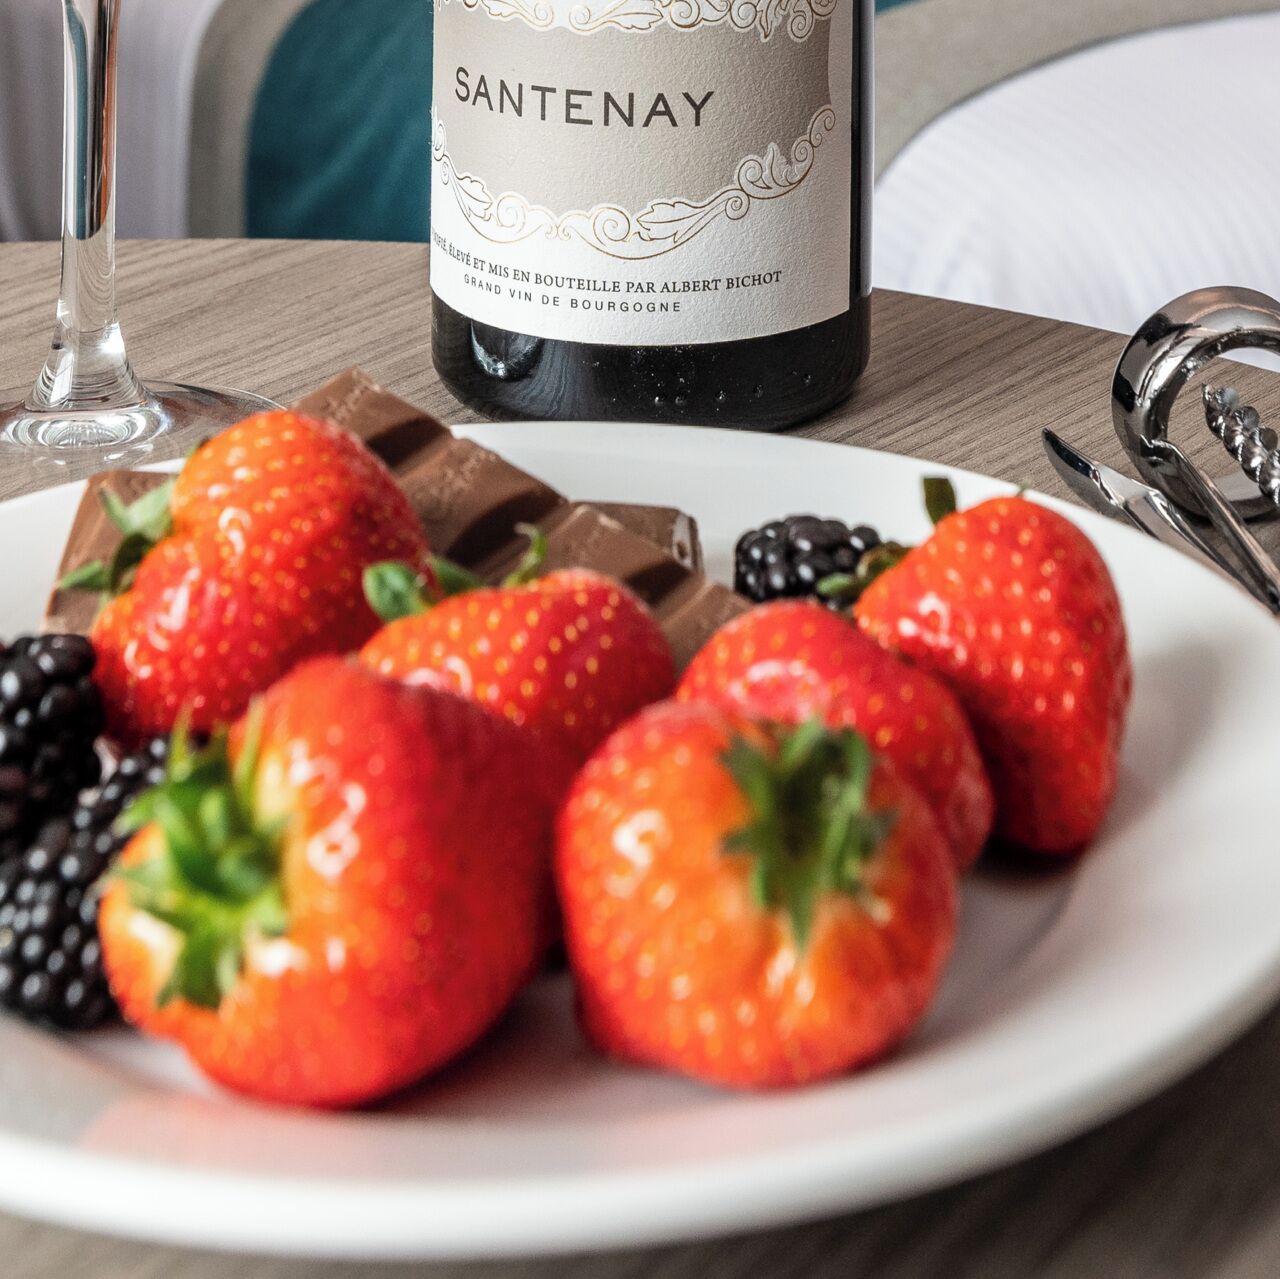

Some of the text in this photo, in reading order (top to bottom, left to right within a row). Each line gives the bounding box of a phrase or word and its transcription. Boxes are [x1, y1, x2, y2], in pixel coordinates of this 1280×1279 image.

[455, 66, 715, 128] SANTENAY
[449, 242, 471, 266] ÉLEVÉ
[473, 257, 485, 271] ET
[488, 262, 509, 278] MIS
[513, 269, 530, 282] EN
[534, 273, 621, 293] BOUTEILLE
[626, 281, 656, 293] PAR
[660, 279, 722, 293] ALBERT
[726, 270, 782, 290] BICHOT
[464, 273, 680, 312] GRAND VIN DE BOURGOGNE
